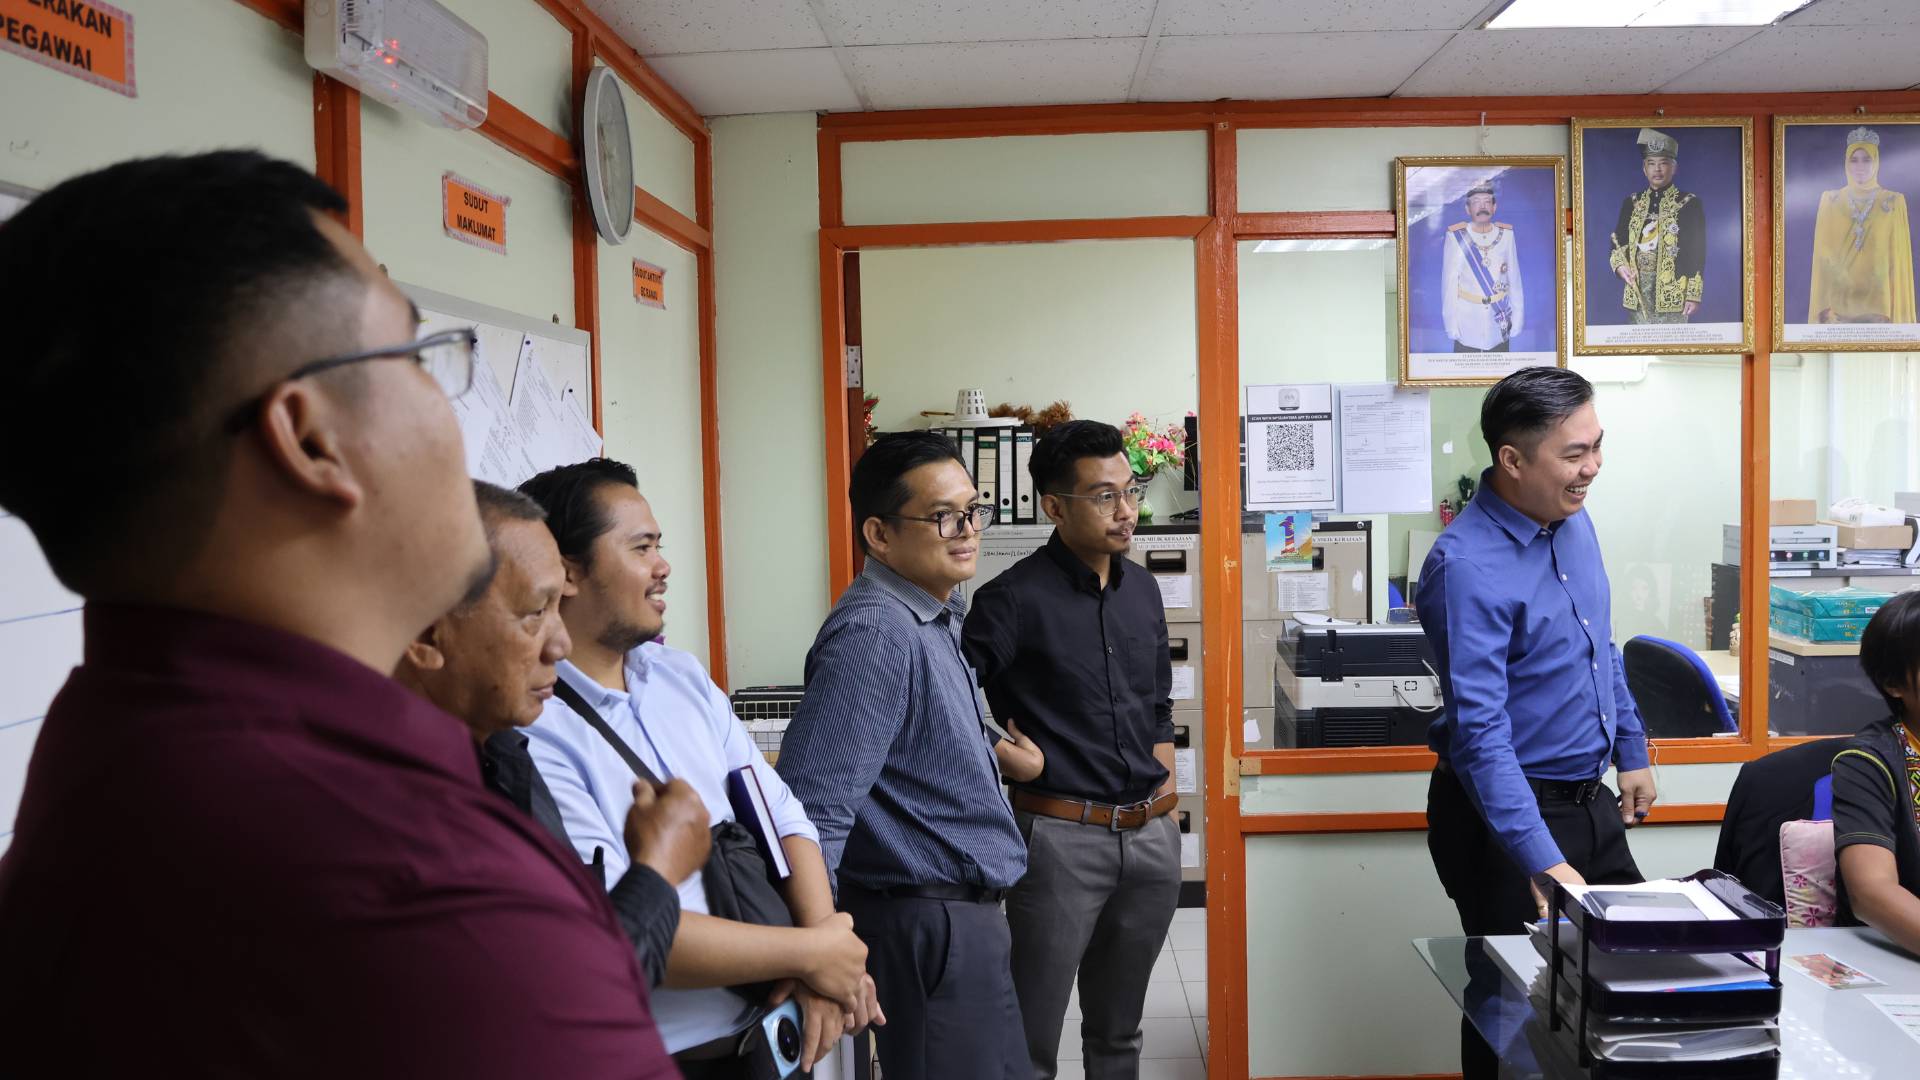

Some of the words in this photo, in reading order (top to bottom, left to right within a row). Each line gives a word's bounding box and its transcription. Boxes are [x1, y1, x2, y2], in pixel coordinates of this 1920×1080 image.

[27, 0, 112, 38] RAKAN
[463, 191, 489, 214] SUDUT
[456, 213, 496, 240] MAKLUMAT
